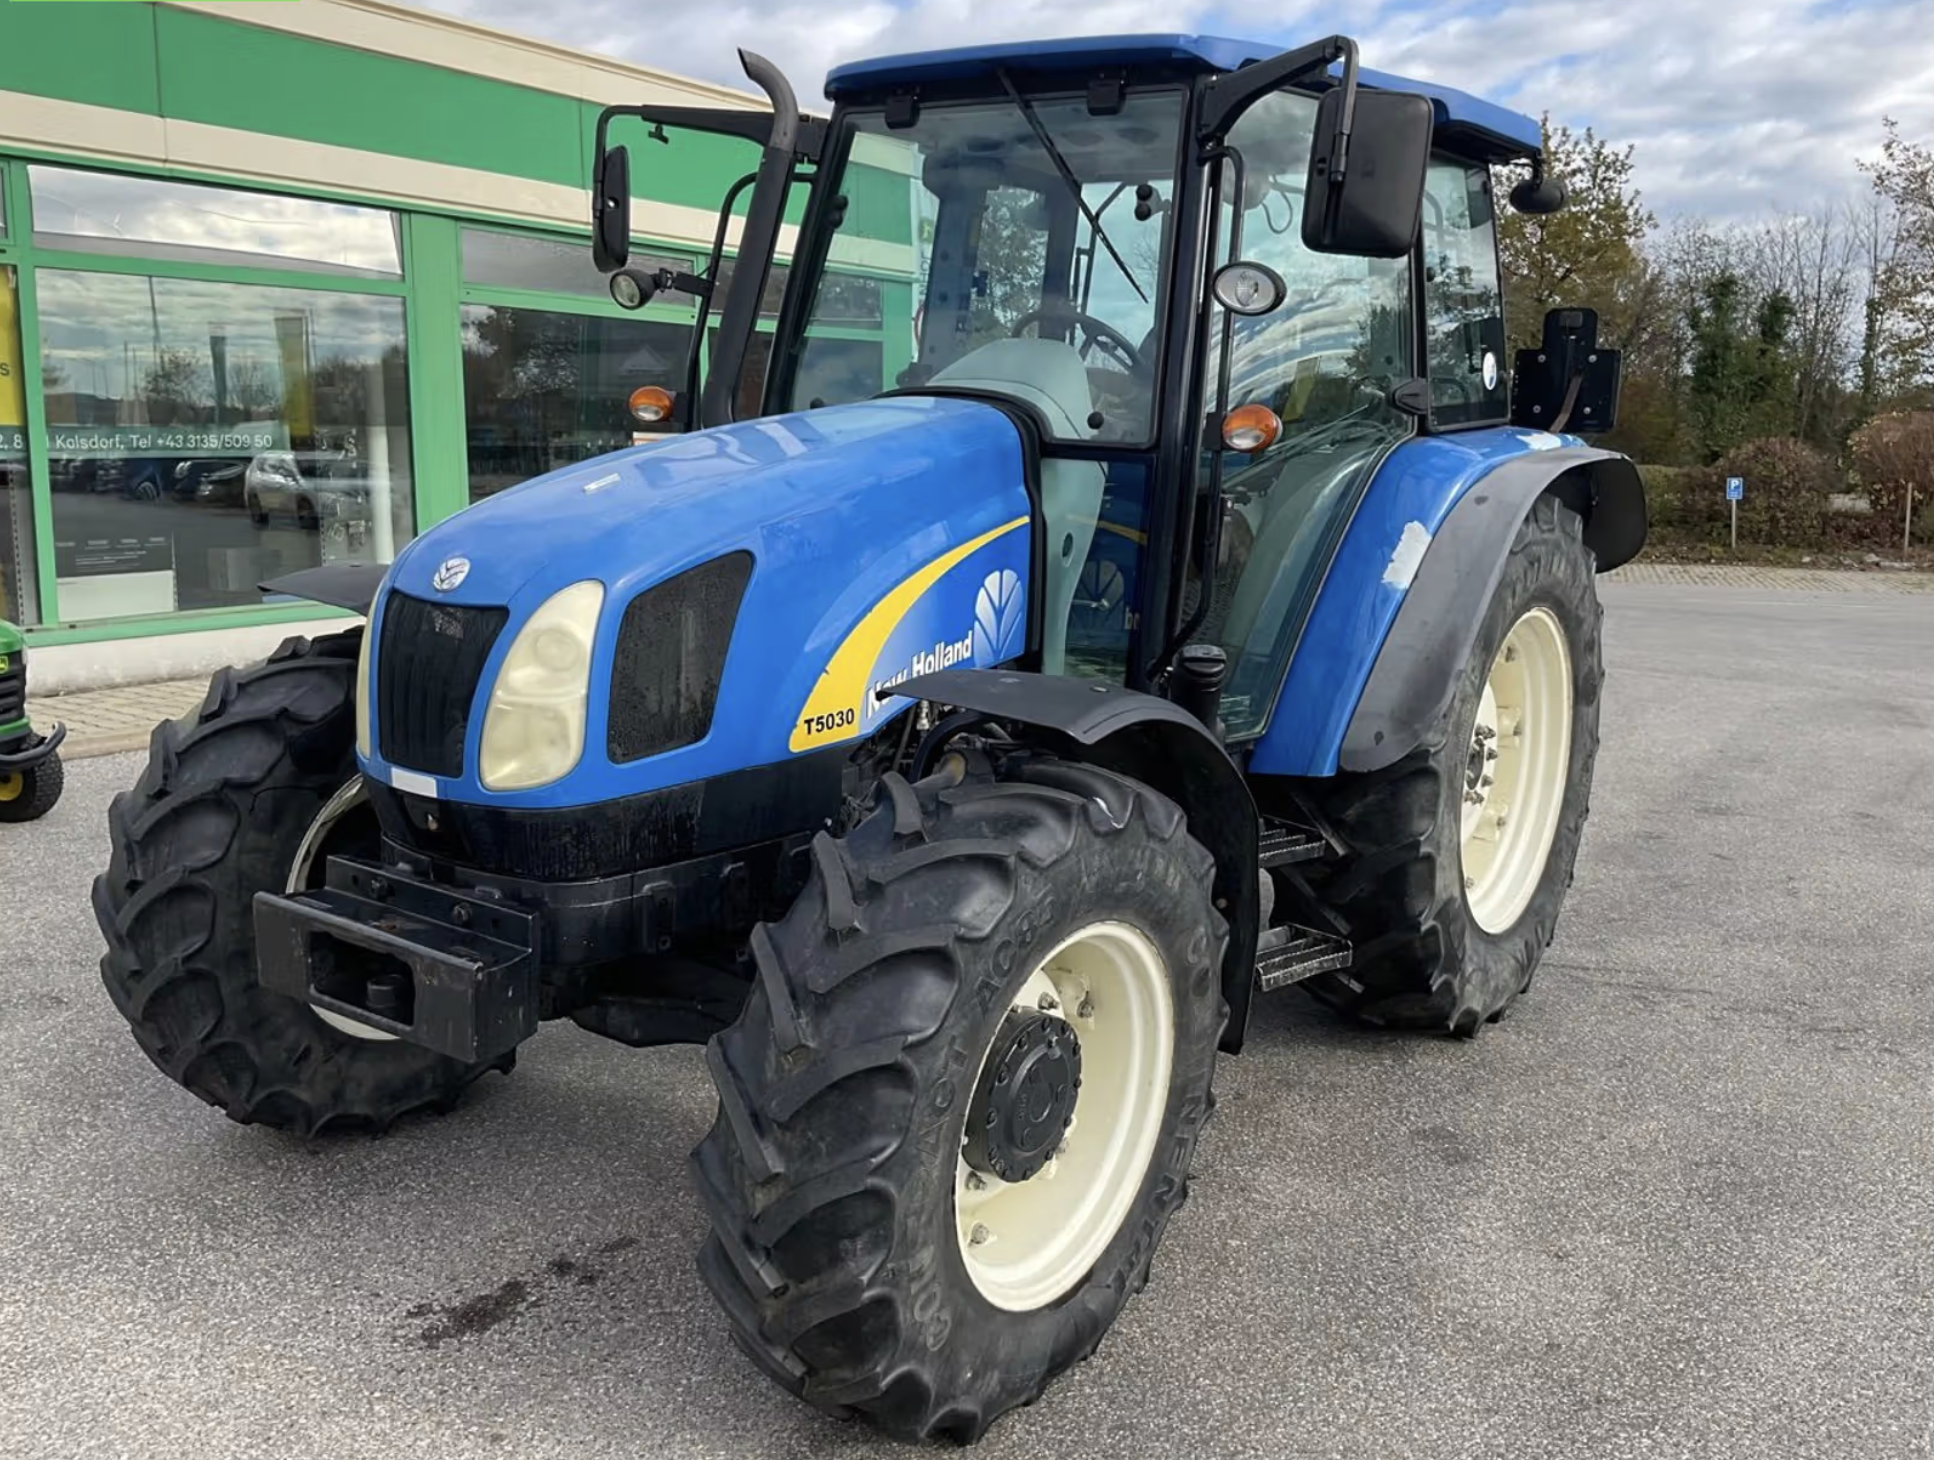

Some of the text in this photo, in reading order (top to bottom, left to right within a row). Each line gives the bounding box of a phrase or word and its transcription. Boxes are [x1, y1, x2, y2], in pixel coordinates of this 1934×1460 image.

[55, 434, 124, 450] Kalsdorf,
[129, 434, 151, 448] Tel
[157, 434, 184, 448] +43
[254, 434, 273, 448] 50
[1730, 480, 1740, 490] P
[911, 630, 973, 678] Holland
[804, 708, 855, 736] T5030
